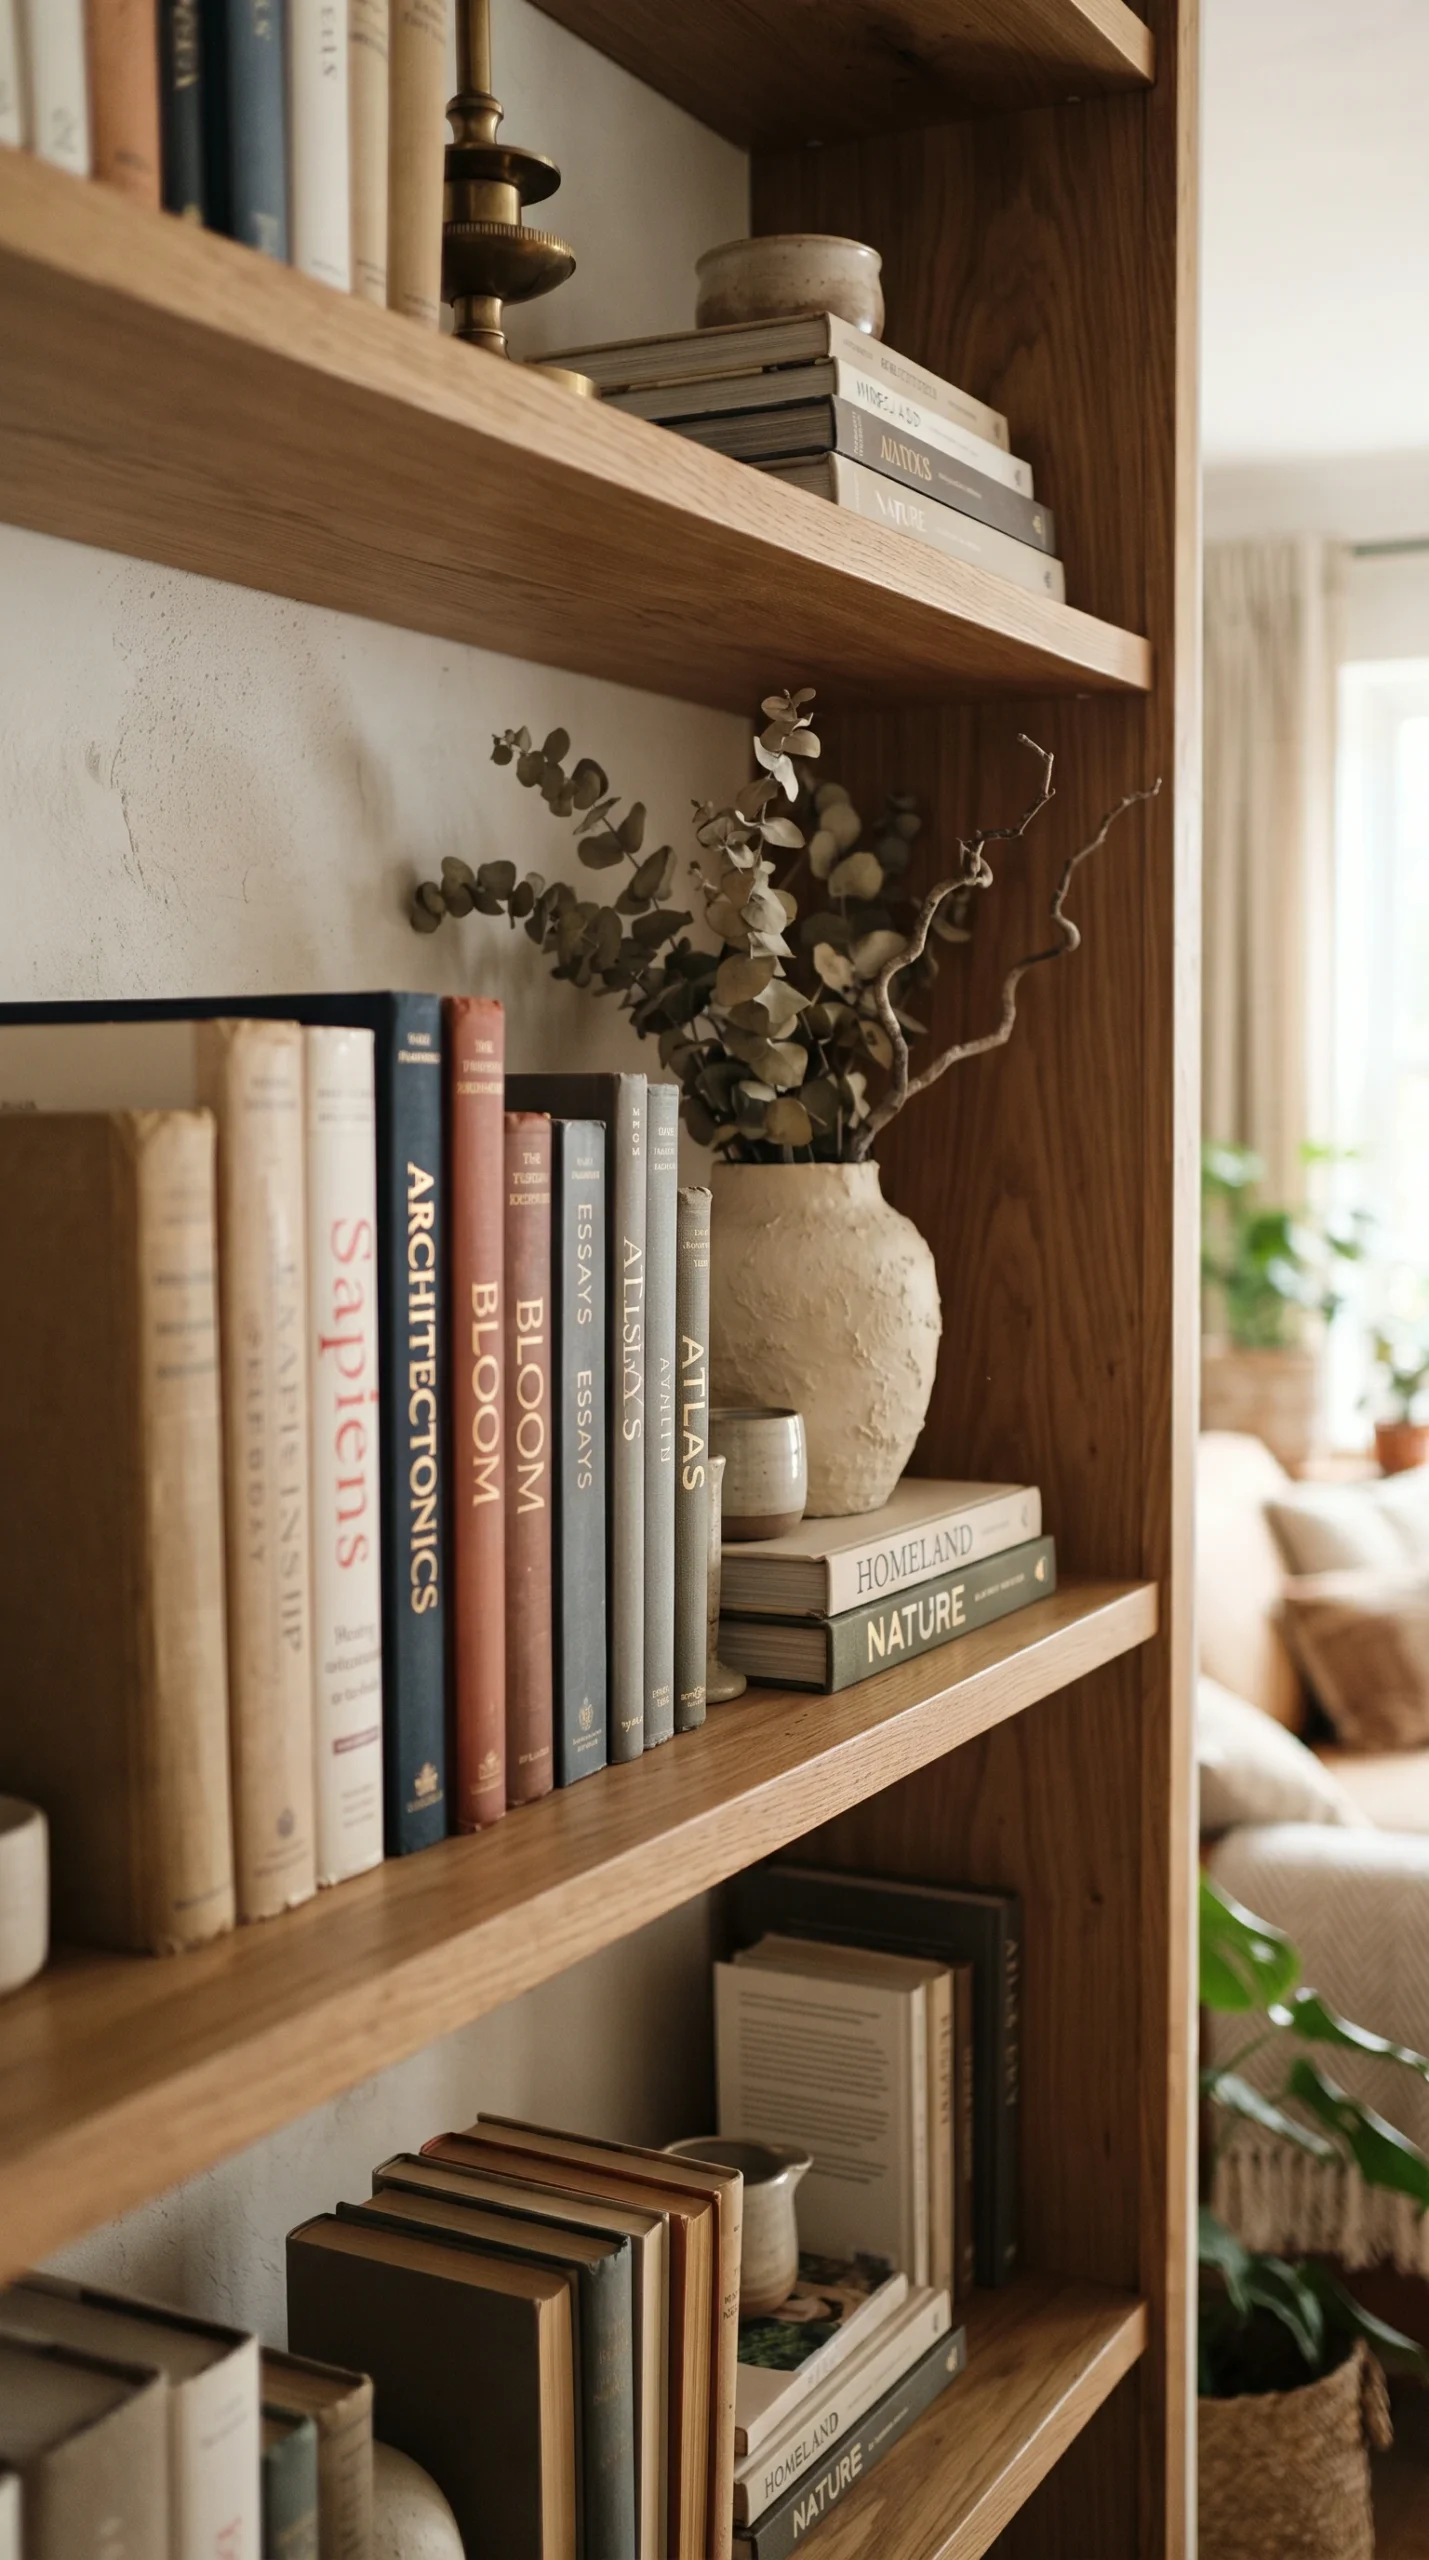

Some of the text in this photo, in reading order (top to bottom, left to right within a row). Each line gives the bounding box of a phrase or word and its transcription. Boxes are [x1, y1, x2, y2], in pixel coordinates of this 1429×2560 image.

[318, 1218, 380, 1570] Sapiens
[406, 1162, 439, 1615] ARCHITECTONICS
[470, 1281, 502, 1508] BLOOM
[515, 1297, 546, 1514] BLOOM
[576, 1203, 593, 1490] ESSAYS ESSAYS
[681, 1334, 706, 1491] ATLAS
[856, 1523, 973, 1595] HOMELAND
[866, 1583, 966, 1664] NATURE
[764, 2411, 840, 2500] HOMELAND
[792, 2442, 864, 2539] NATURE
